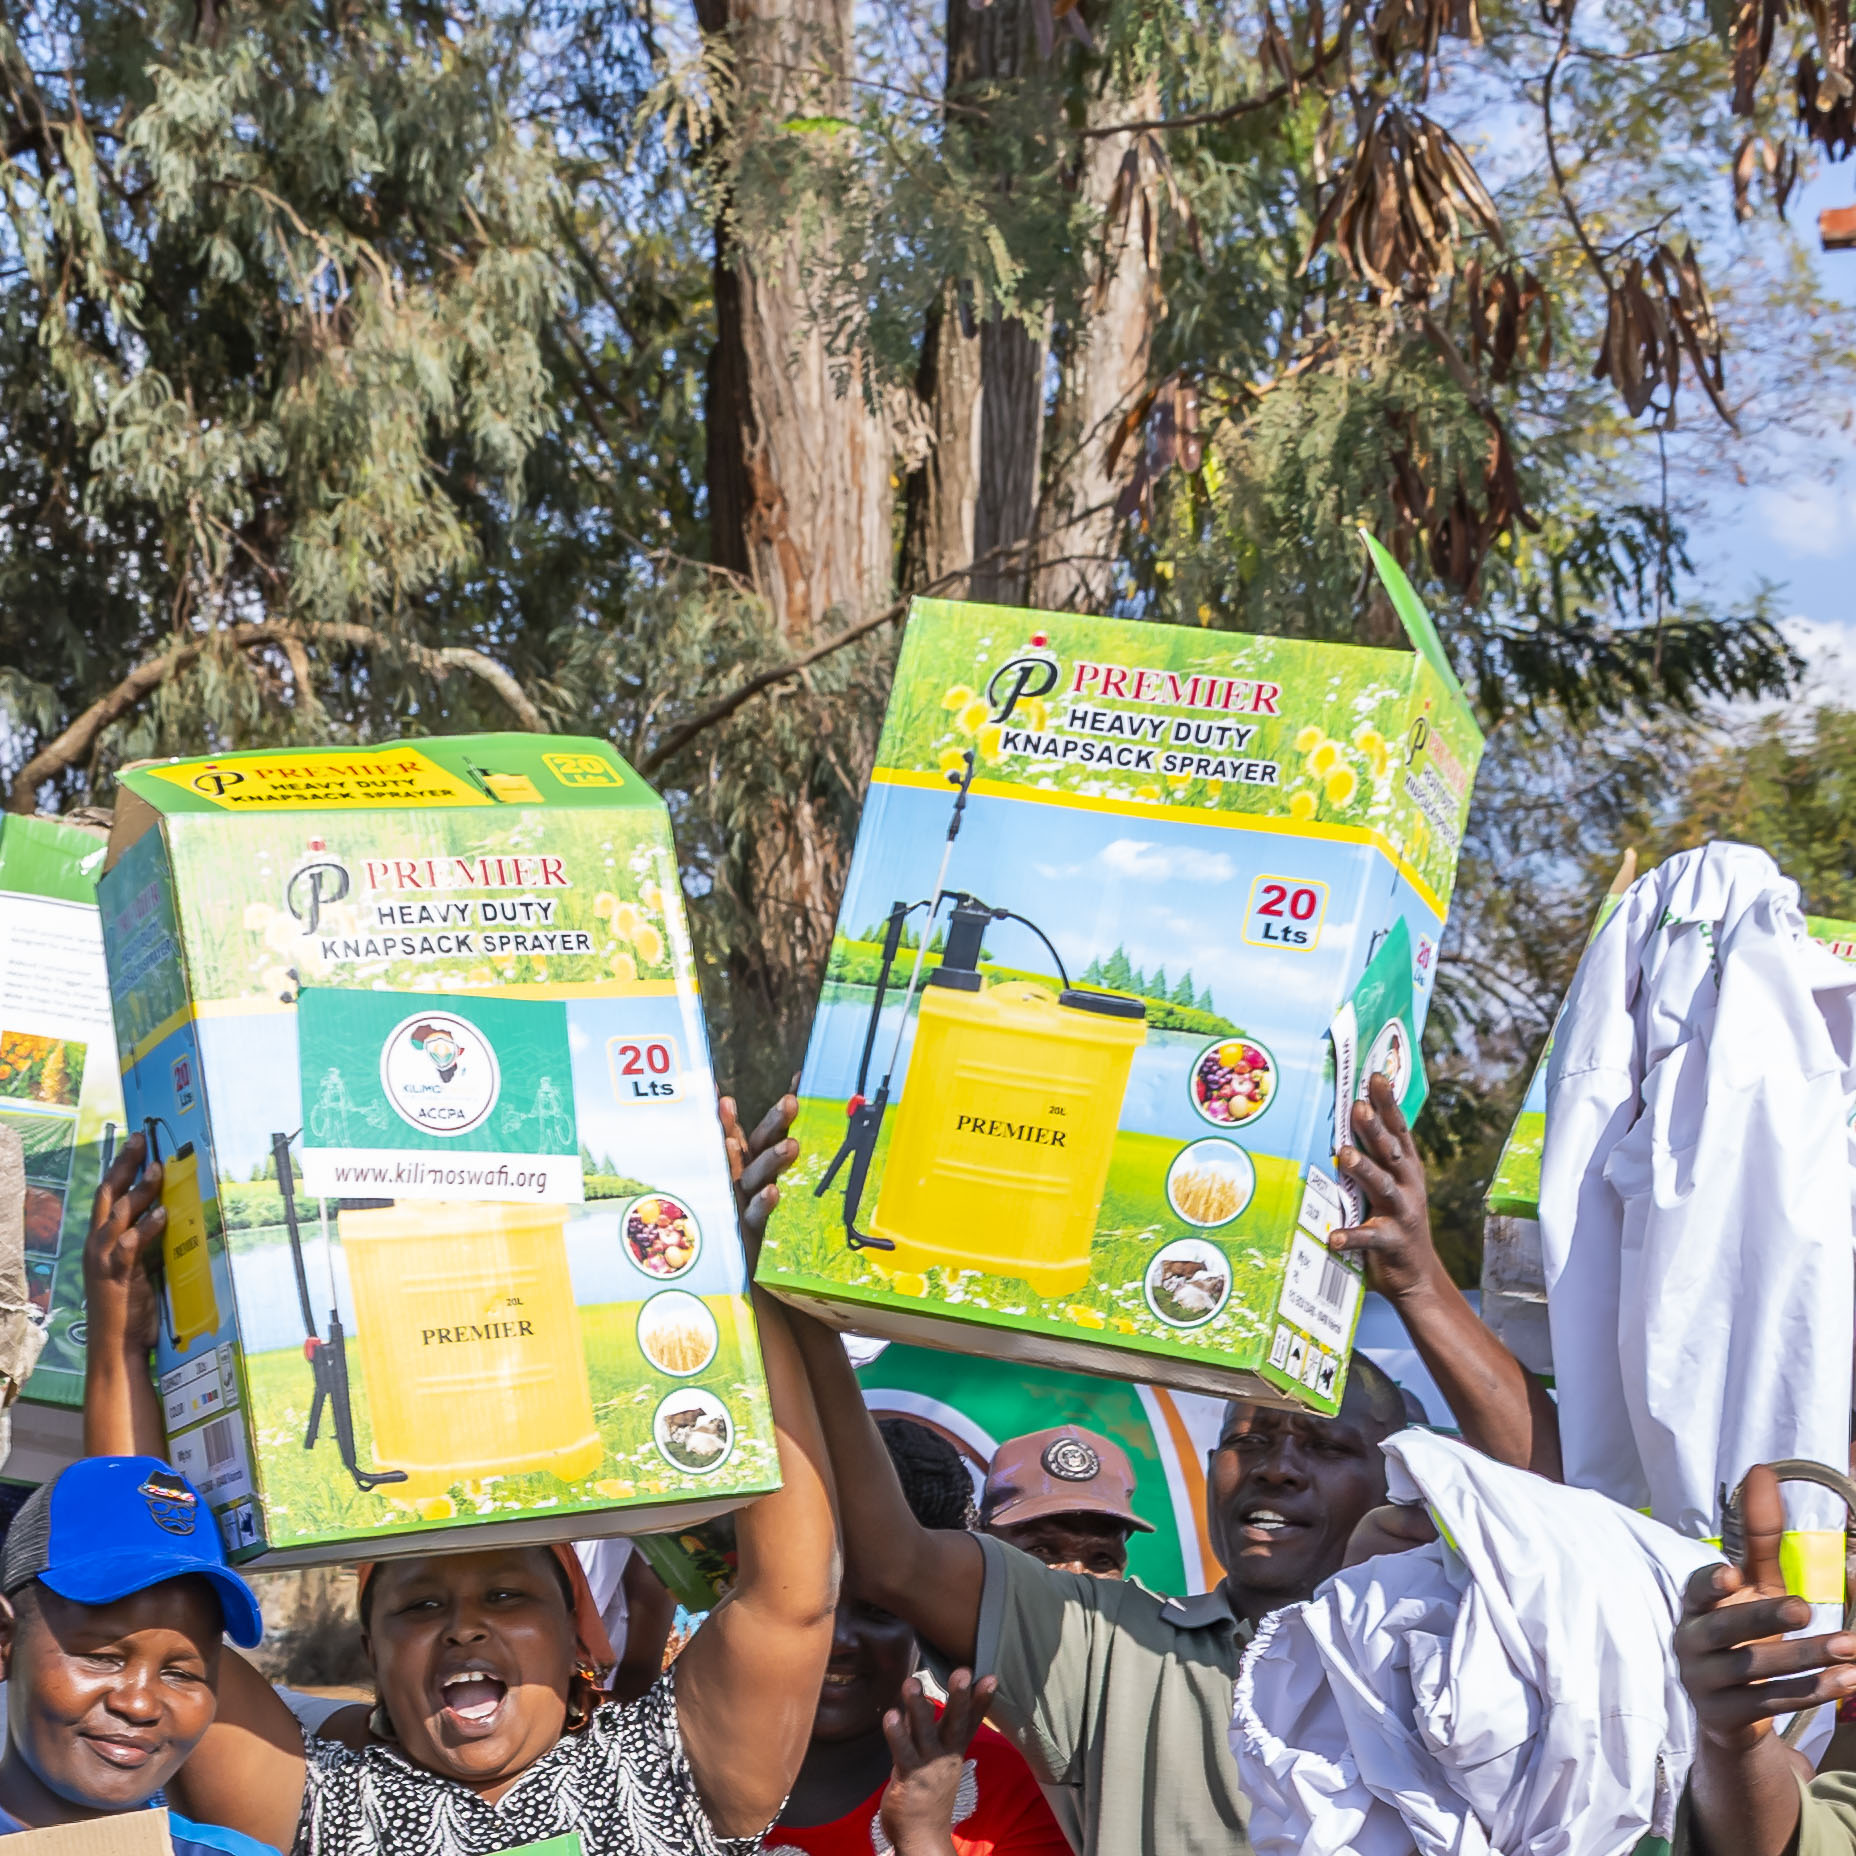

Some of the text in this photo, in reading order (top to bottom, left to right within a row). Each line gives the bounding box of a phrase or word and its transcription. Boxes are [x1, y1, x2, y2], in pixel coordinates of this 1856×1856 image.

[1072, 663, 1279, 714] PREMIER
[1069, 708, 1252, 749] HEAVY DUTY
[552, 758, 605, 775] 20
[1002, 731, 1278, 783] KNAPSACK SPRAYER
[254, 760, 424, 780] PREMIER
[231, 788, 456, 803] KNAPSACK SPRAYER
[270, 778, 415, 792] HEAVY DUTY
[365, 857, 569, 890] PREMIER
[377, 901, 553, 925] HEAVY DUTY
[1255, 883, 1317, 920] 20
[1261, 922, 1309, 944] Lts
[321, 934, 591, 959] KNAPSACK SPRAYER
[618, 1043, 670, 1076] 20
[632, 1080, 674, 1097] Lts
[418, 1108, 466, 1120] ACCPA
[955, 1114, 1066, 1148] PREMIER
[334, 1161, 547, 1194] www.kilimoswafi.org
[421, 1320, 534, 1346] PREMIER
